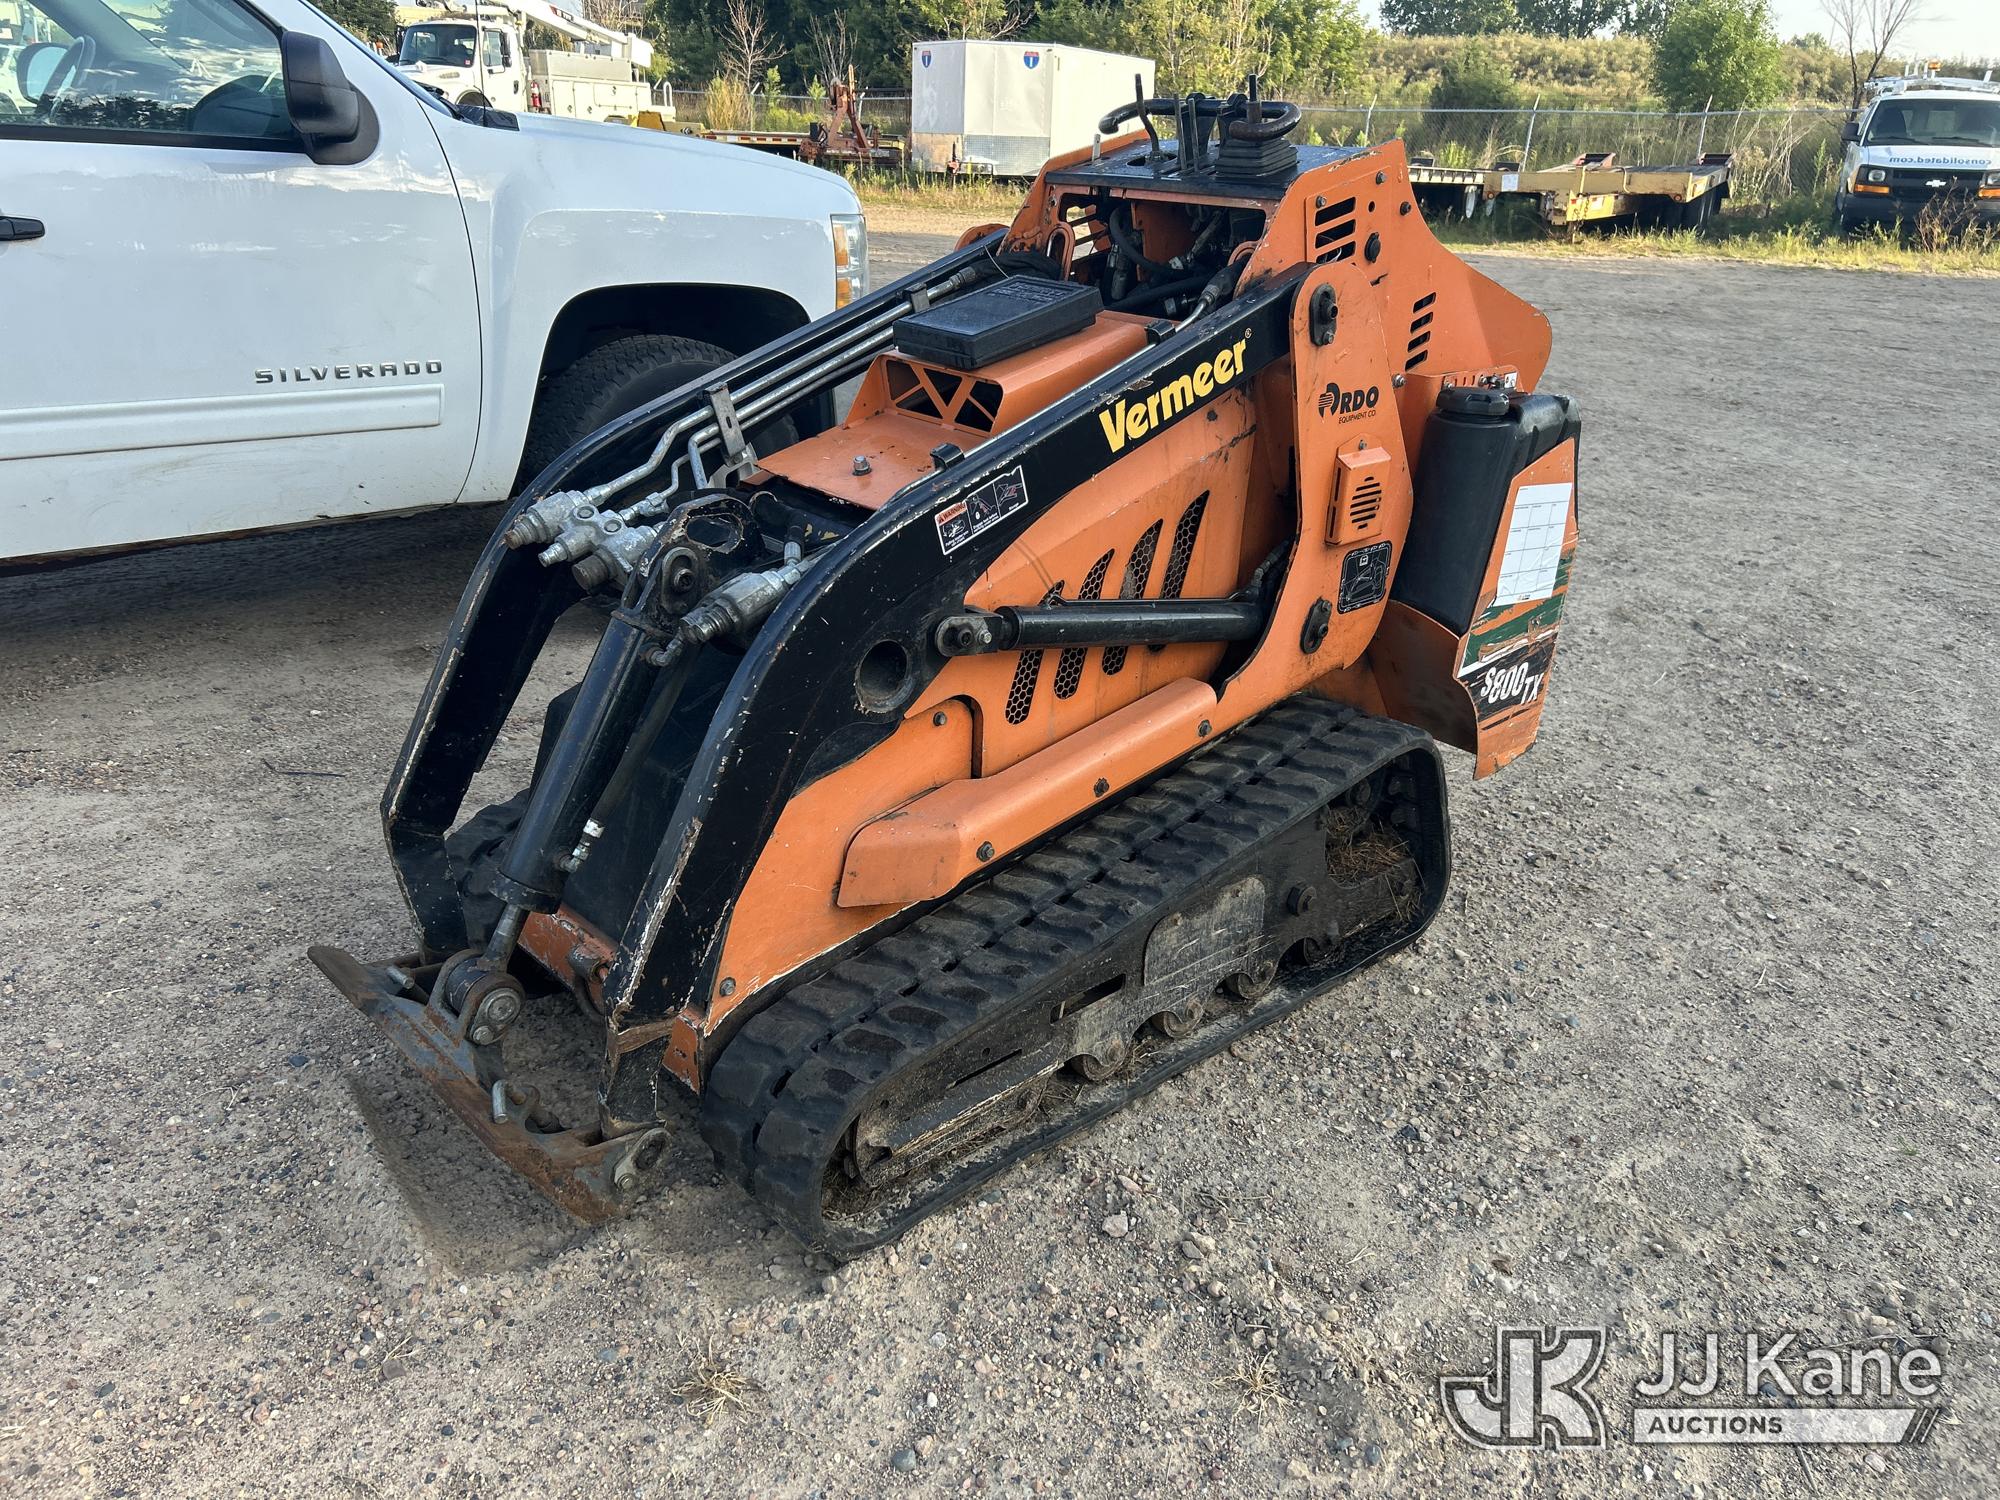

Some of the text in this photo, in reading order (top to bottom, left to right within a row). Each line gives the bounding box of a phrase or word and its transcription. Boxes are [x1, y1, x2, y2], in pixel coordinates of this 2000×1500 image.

[255, 360, 442, 384] SILVERADO
[1098, 338, 1247, 453] Vermeer
[1338, 411, 1367, 424] EQUIPMENT
